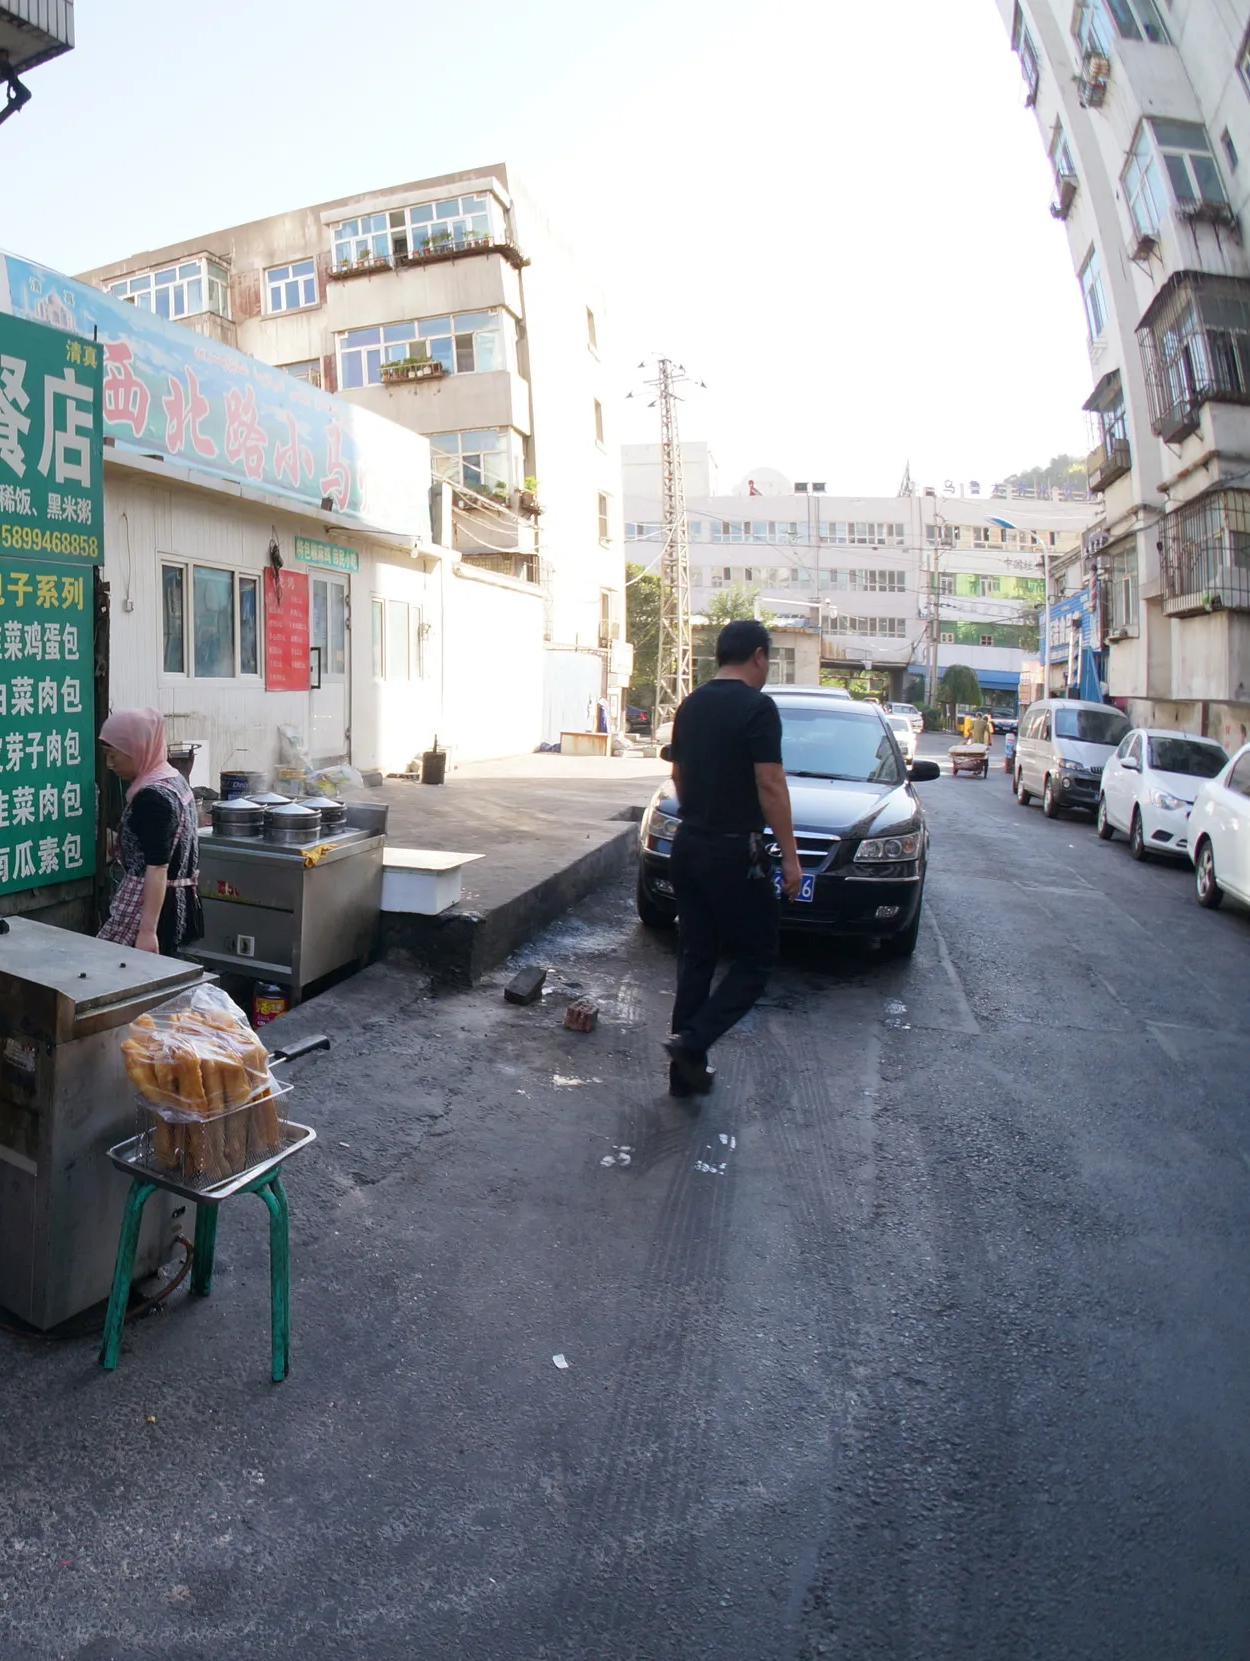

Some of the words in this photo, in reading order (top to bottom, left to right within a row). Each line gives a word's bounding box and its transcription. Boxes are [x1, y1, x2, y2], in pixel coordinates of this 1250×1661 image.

[66, 339, 98, 369] 清真
[103, 342, 367, 512] 西北路小马
